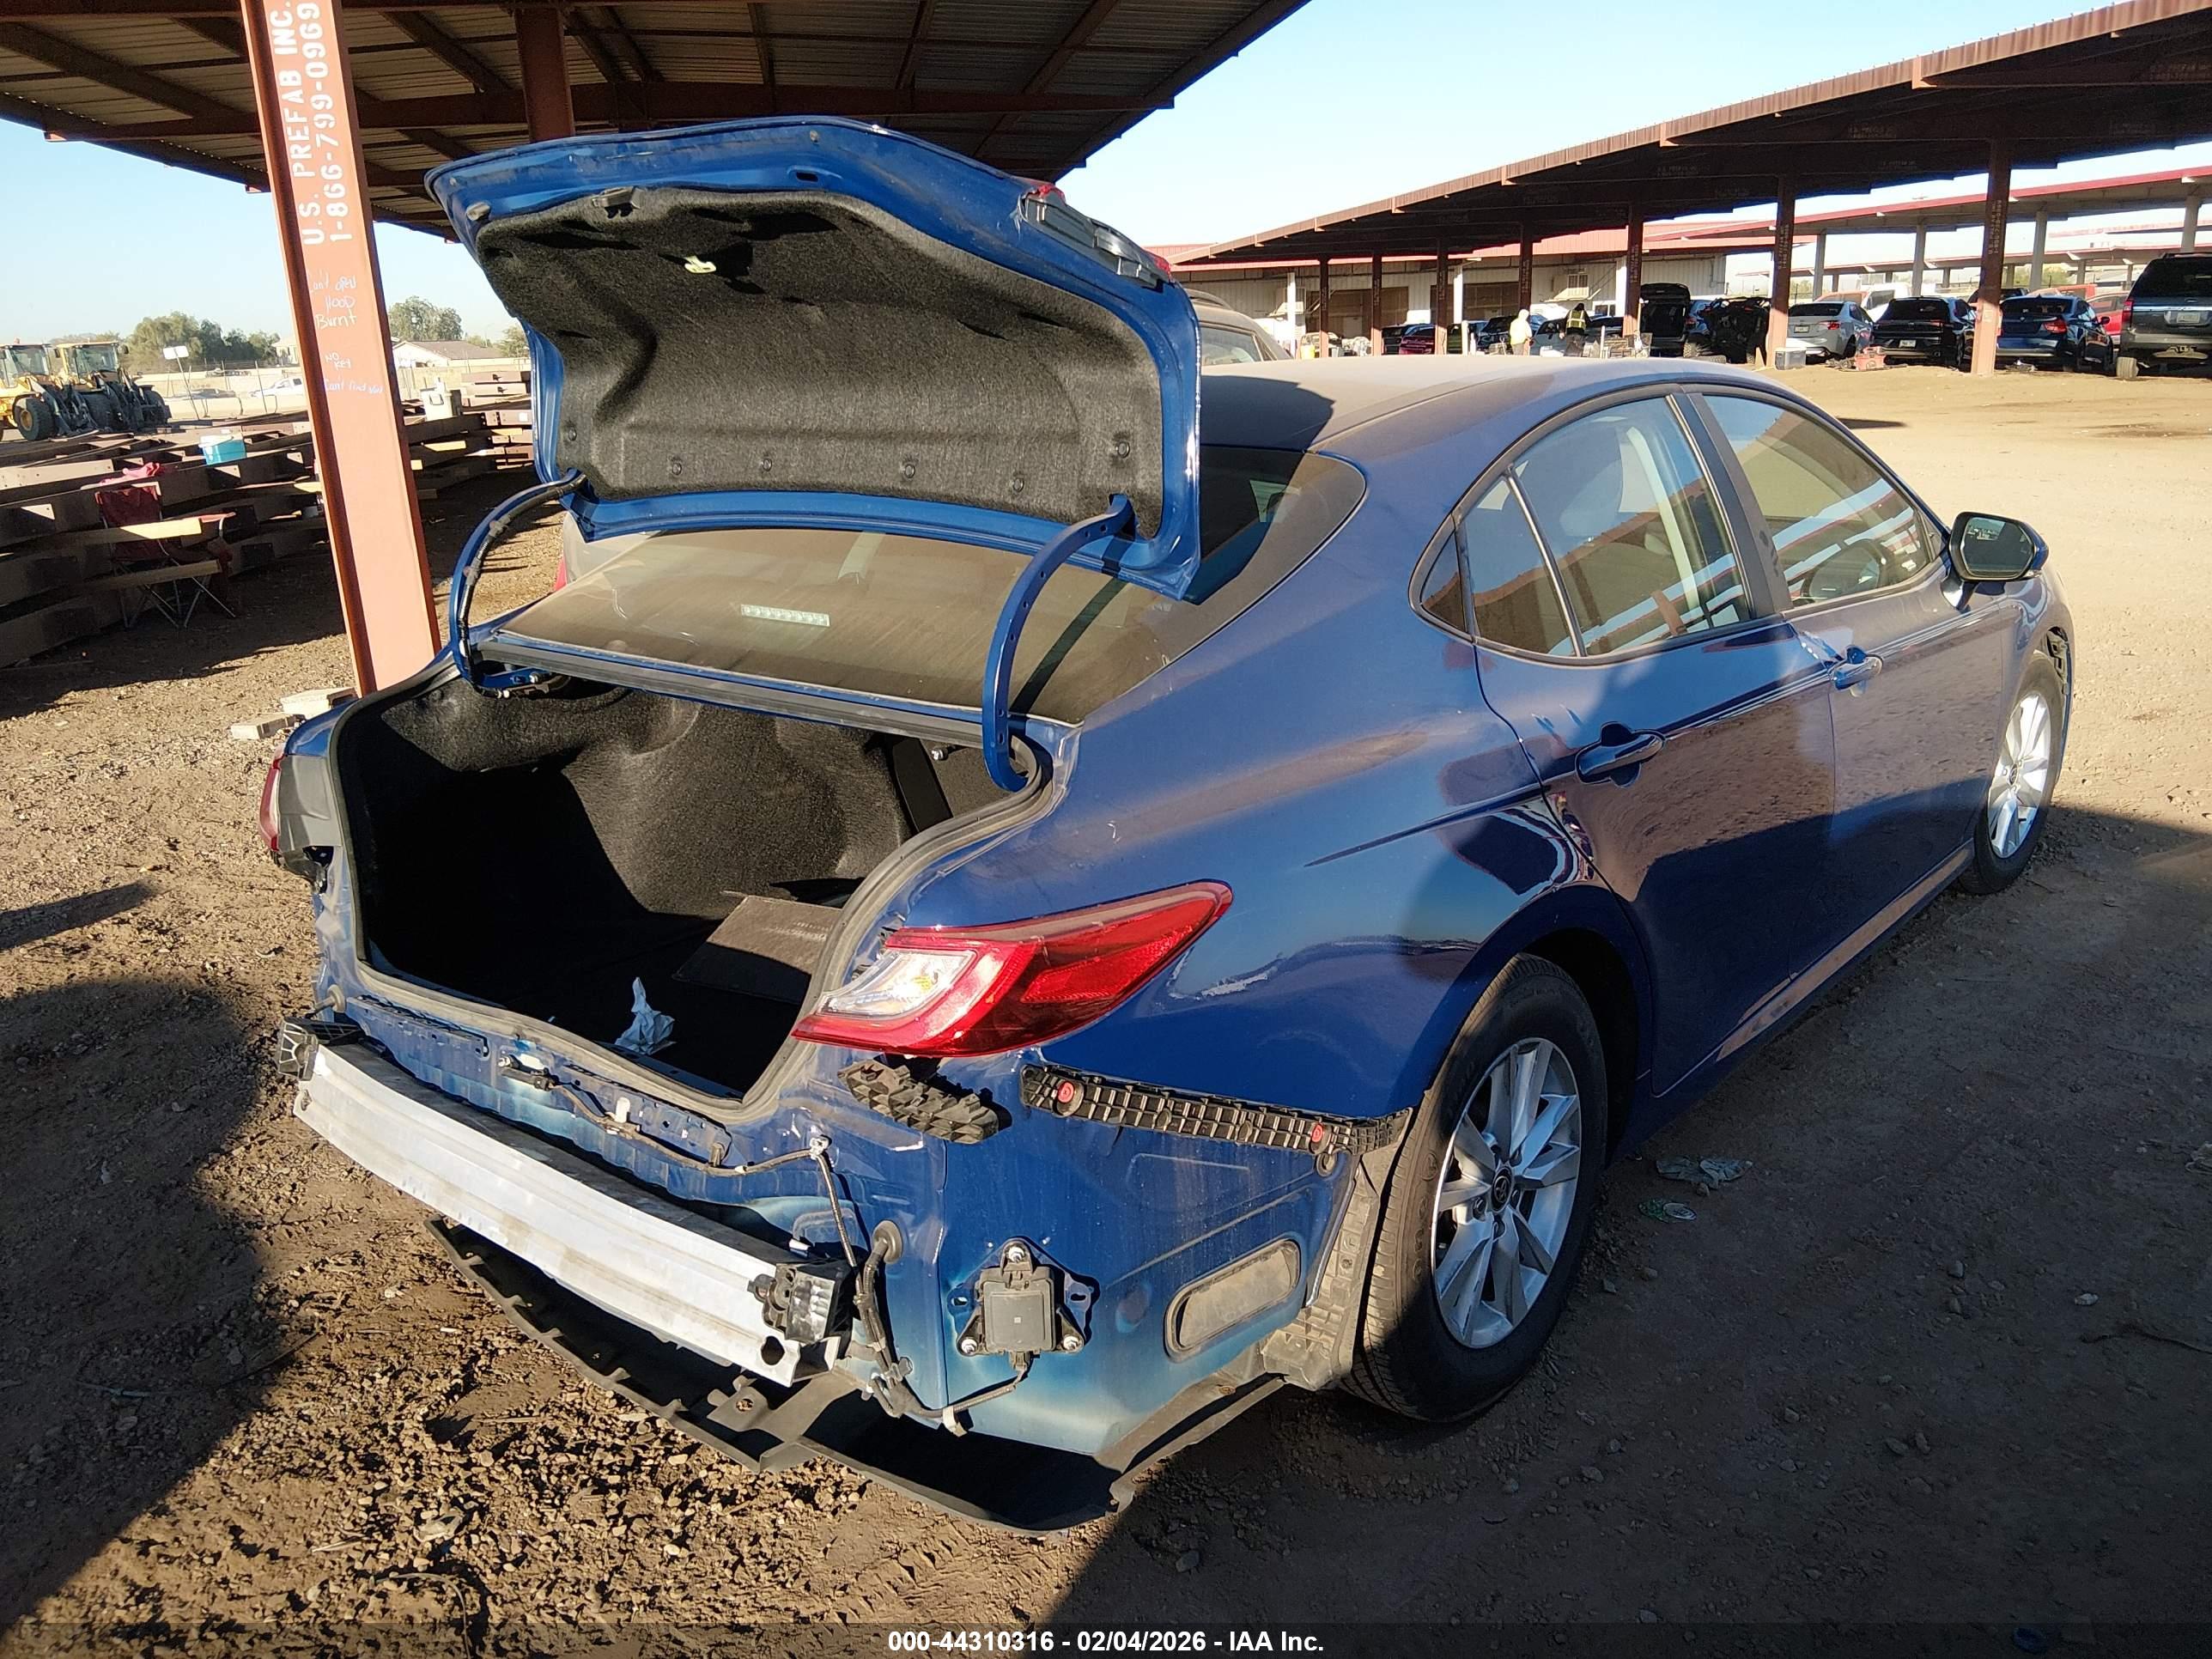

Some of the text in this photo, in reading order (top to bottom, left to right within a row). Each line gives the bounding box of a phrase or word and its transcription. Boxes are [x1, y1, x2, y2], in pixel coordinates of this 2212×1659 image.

[269, 0, 325, 246] U.S. PREFAB INC.
[296, 3, 353, 242] 1-866-799-0969
